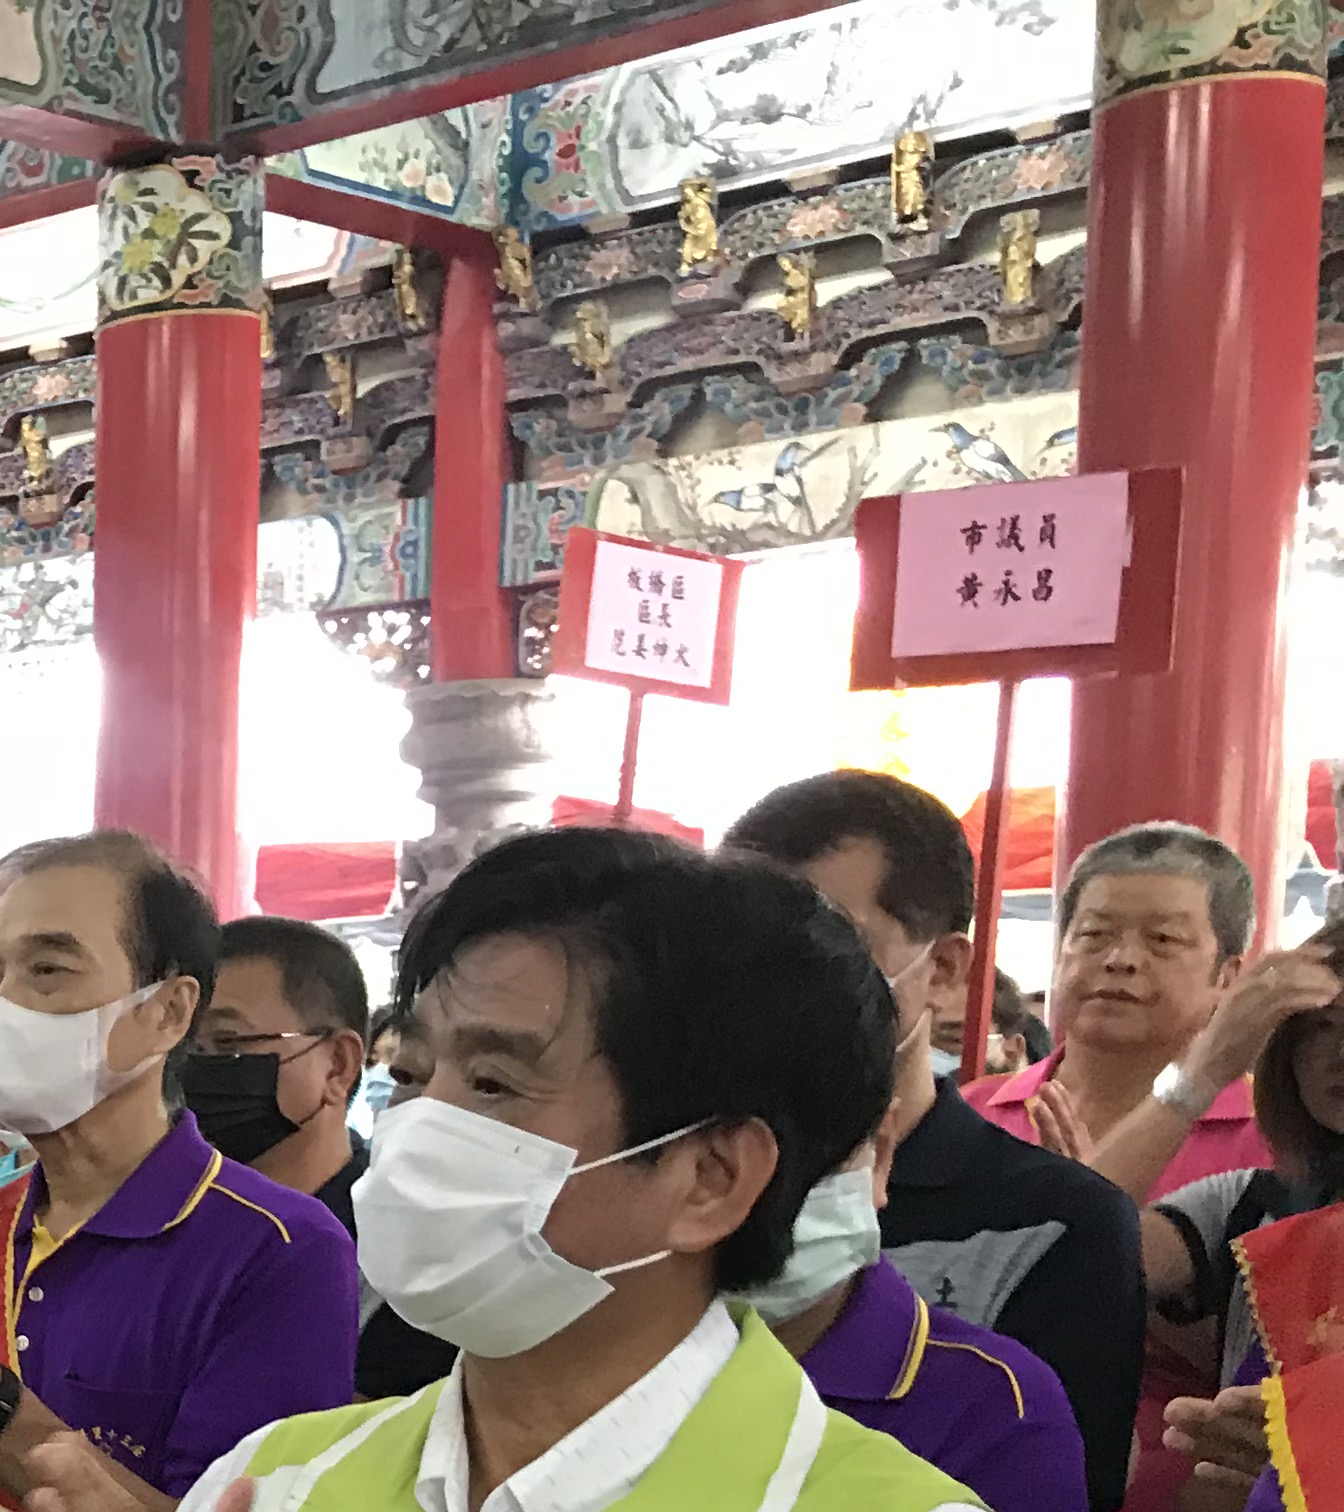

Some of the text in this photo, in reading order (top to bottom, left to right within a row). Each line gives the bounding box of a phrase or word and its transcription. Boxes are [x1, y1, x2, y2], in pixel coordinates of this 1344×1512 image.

[959, 512, 1056, 555] 市議員
[955, 568, 1053, 608] 黃永昌
